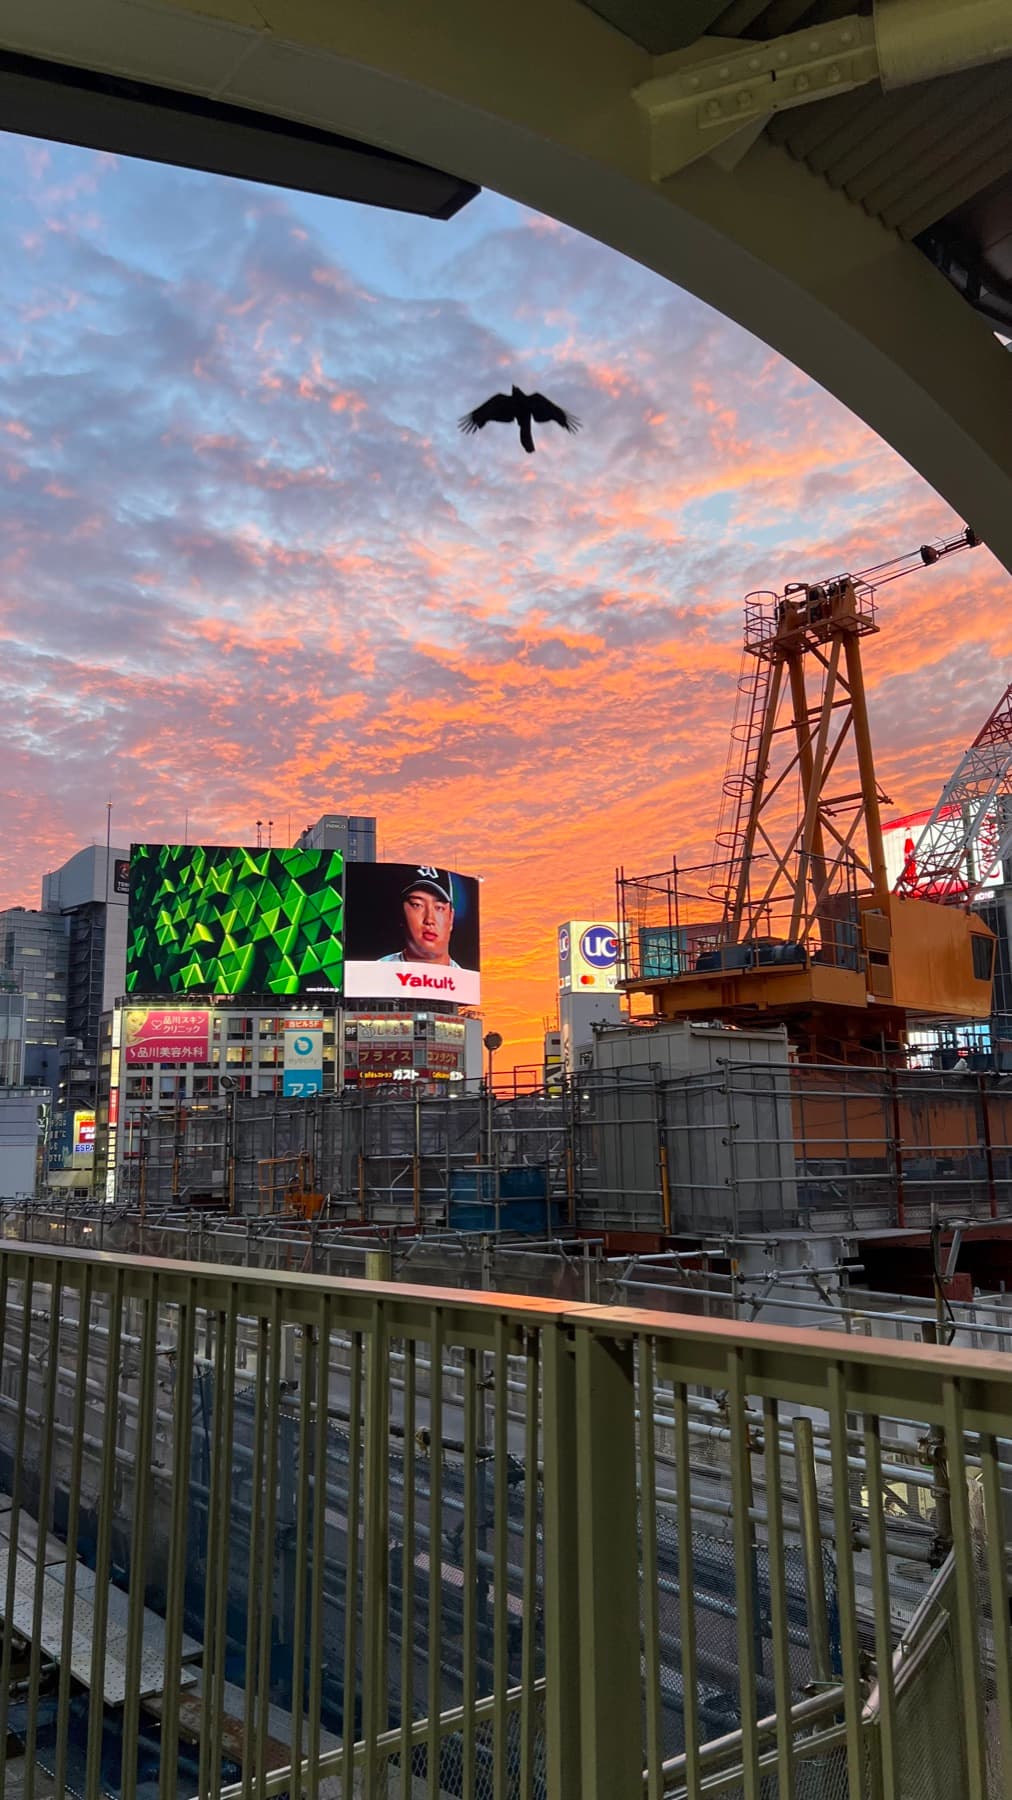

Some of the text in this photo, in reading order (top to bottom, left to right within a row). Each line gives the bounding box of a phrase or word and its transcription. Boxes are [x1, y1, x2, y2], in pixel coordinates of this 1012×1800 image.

[584, 937, 617, 957] UC
[396, 973, 456, 991] Yakult
[163, 1016, 205, 1025] 品川スキン
[163, 1025, 201, 1034] クリニック
[137, 1047, 203, 1058] 品川美容外科
[393, 1069, 420, 1081] ガスト
